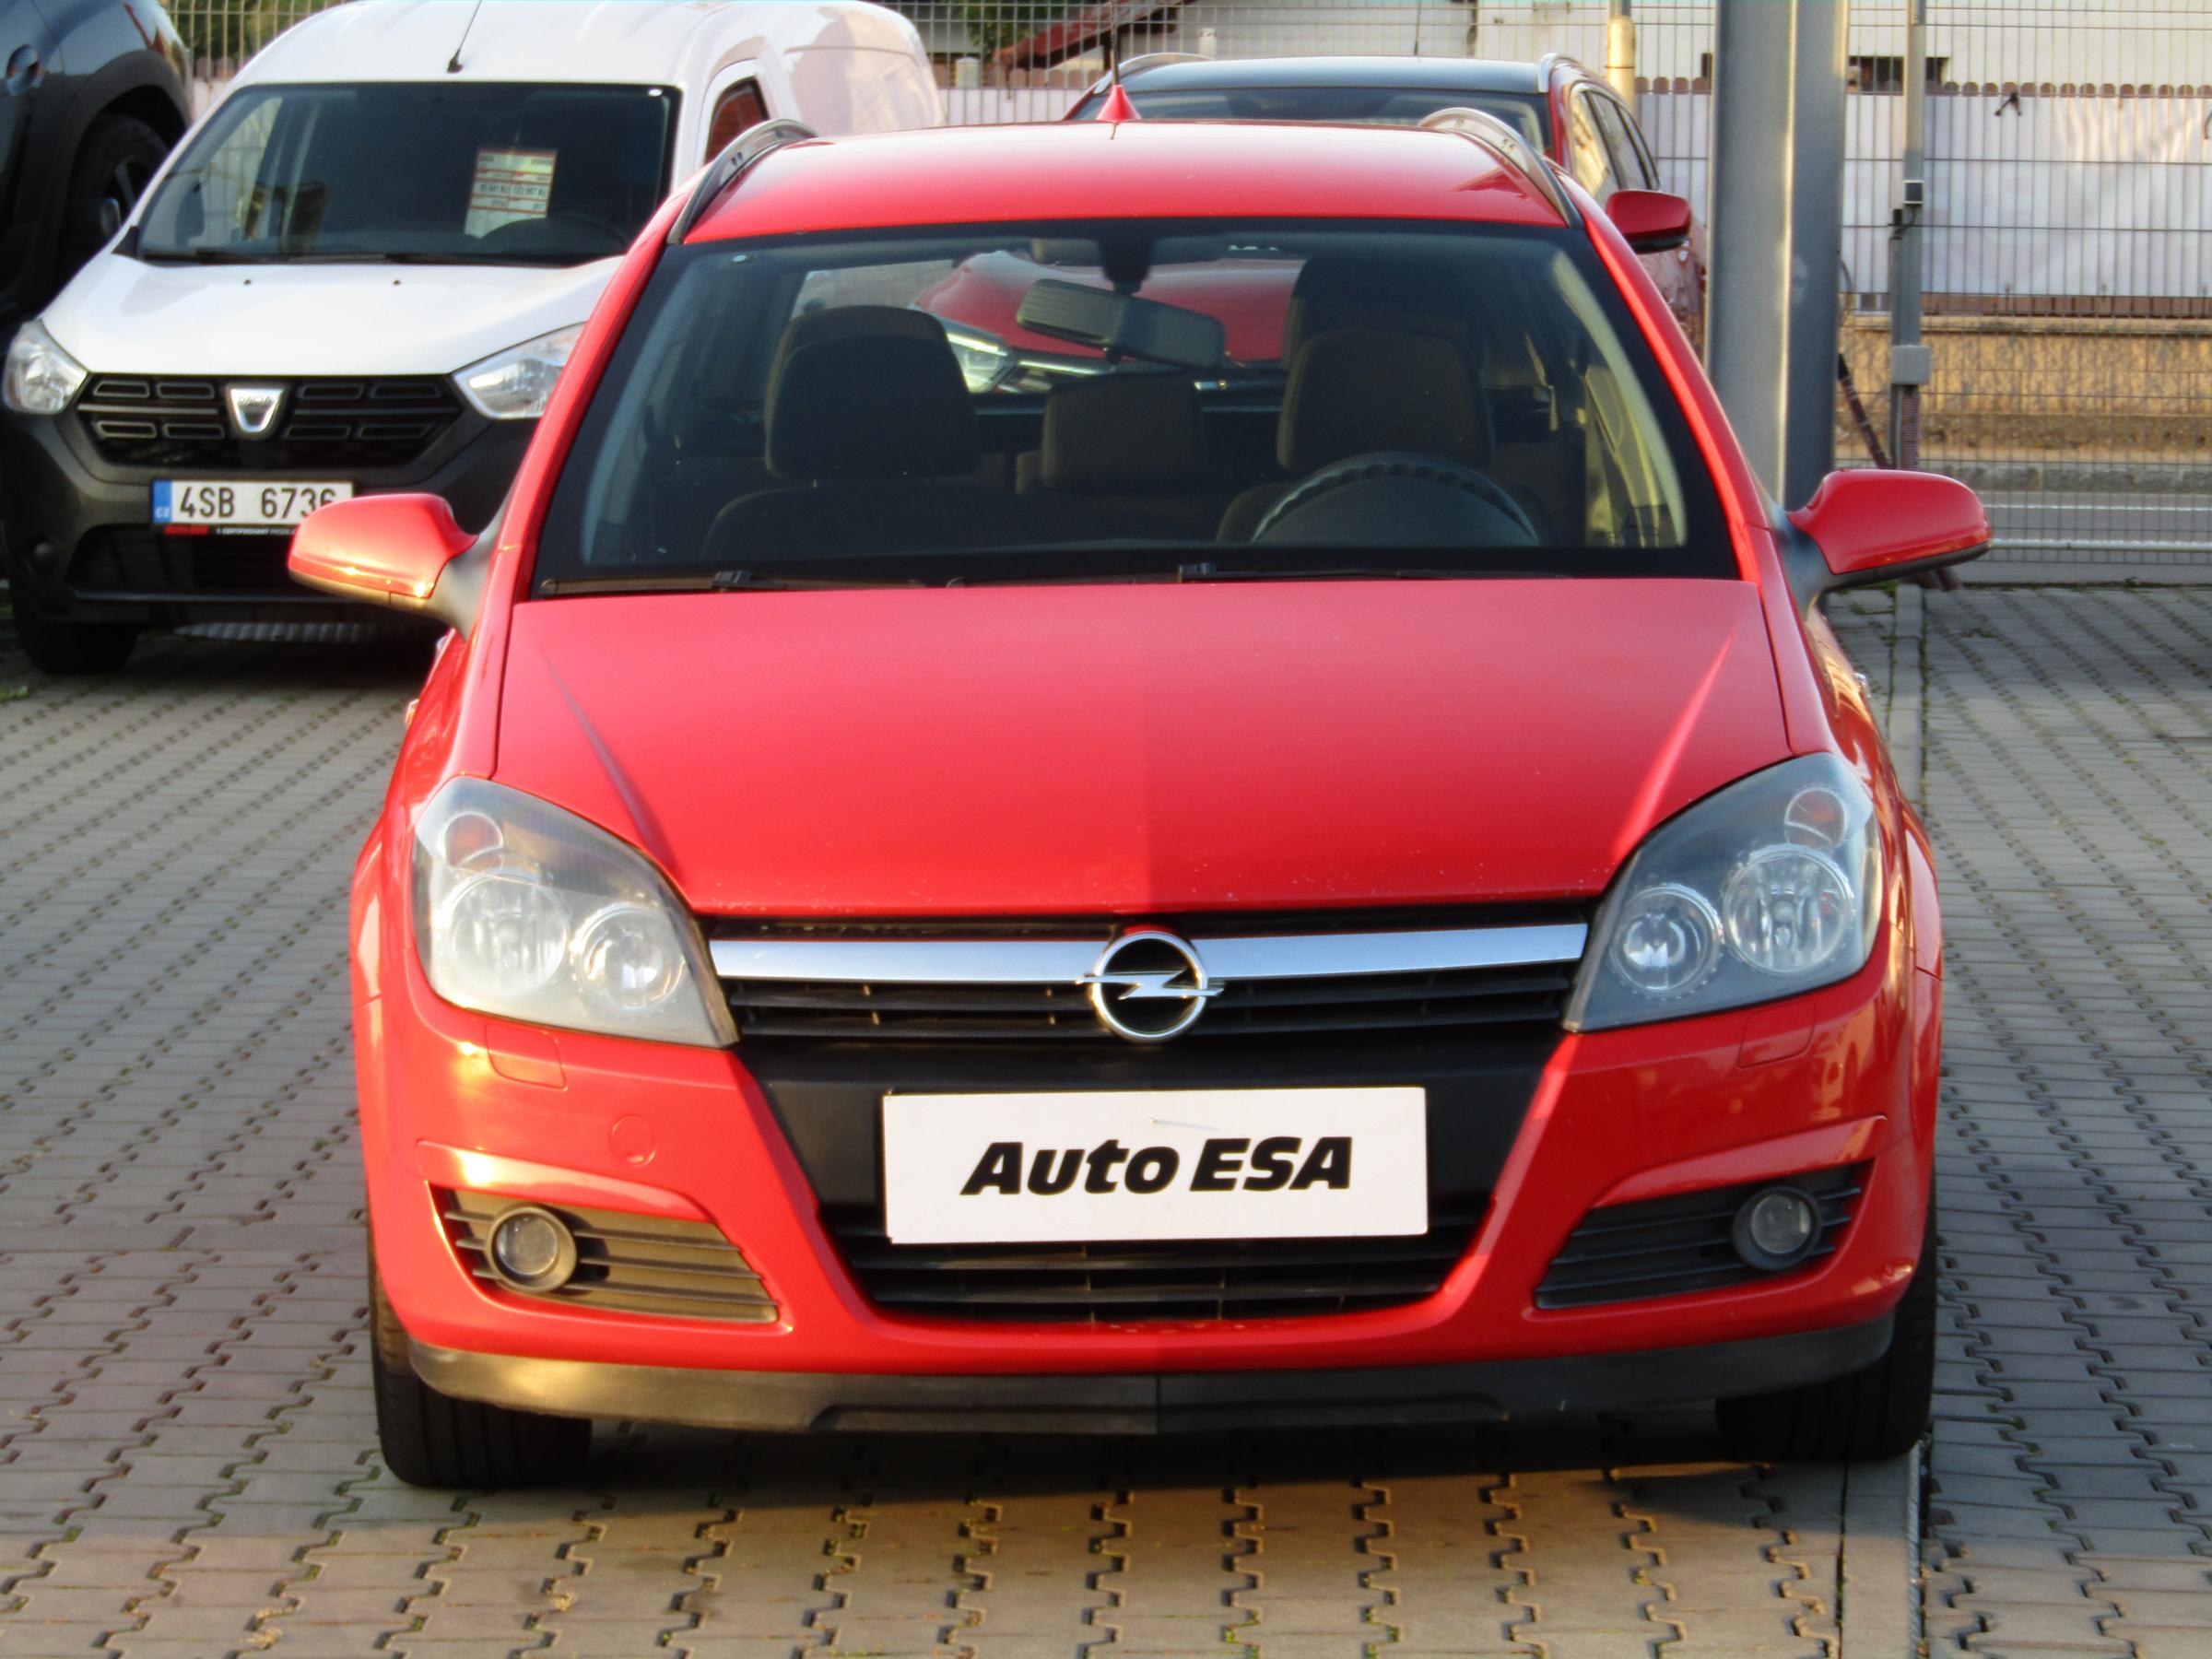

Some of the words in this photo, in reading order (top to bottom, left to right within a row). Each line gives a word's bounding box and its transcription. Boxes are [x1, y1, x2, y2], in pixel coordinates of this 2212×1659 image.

[156, 507, 171, 519] CZ
[179, 486, 235, 518] 4SB
[959, 1138, 1181, 1196] Auto
[1189, 1135, 1353, 1193] ESA
